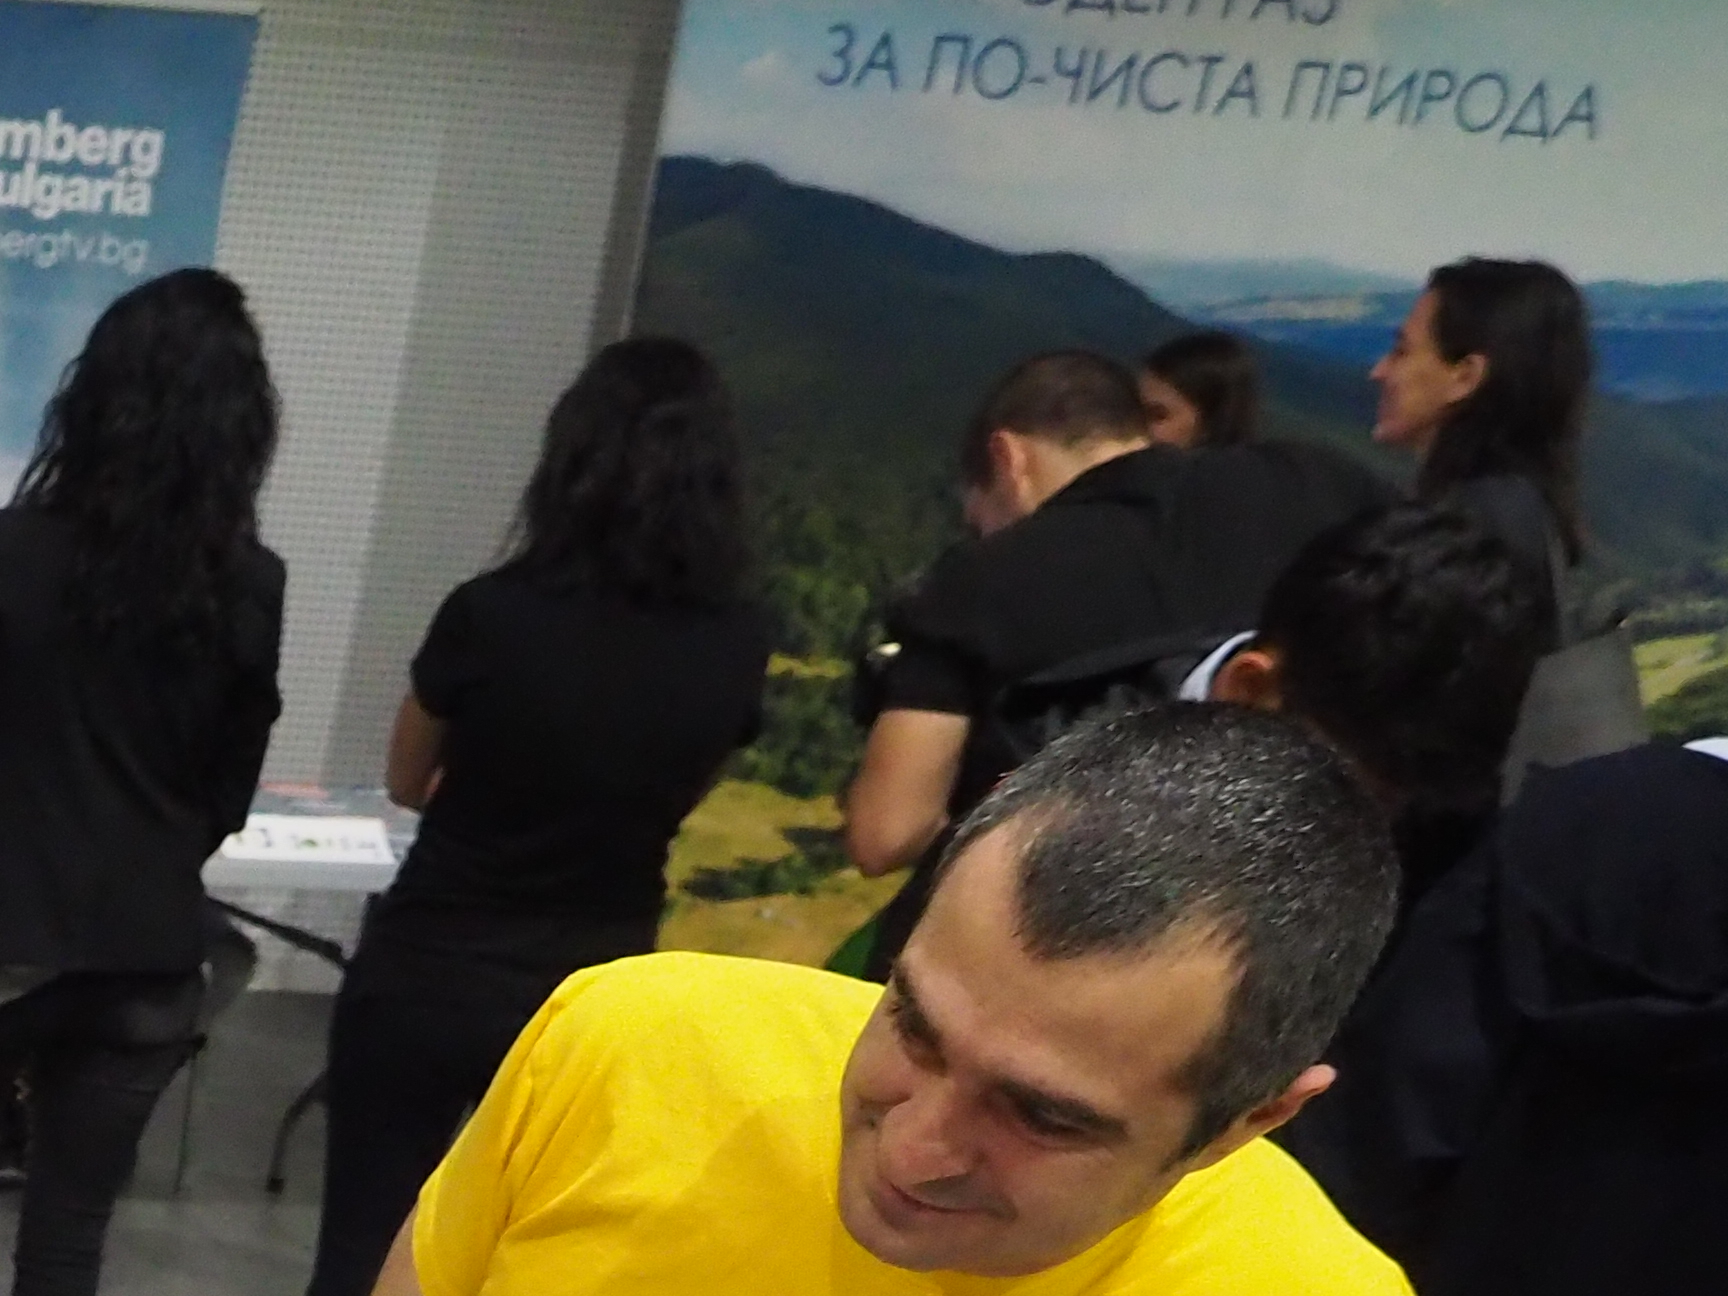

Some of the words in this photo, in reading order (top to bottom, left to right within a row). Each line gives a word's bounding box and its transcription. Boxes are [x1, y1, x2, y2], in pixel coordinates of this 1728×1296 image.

[817, 23, 902, 91] ЗА
[922, 33, 1261, 118] ПО-ЧИСТА
[1282, 60, 1599, 142] ПРИРОДА
